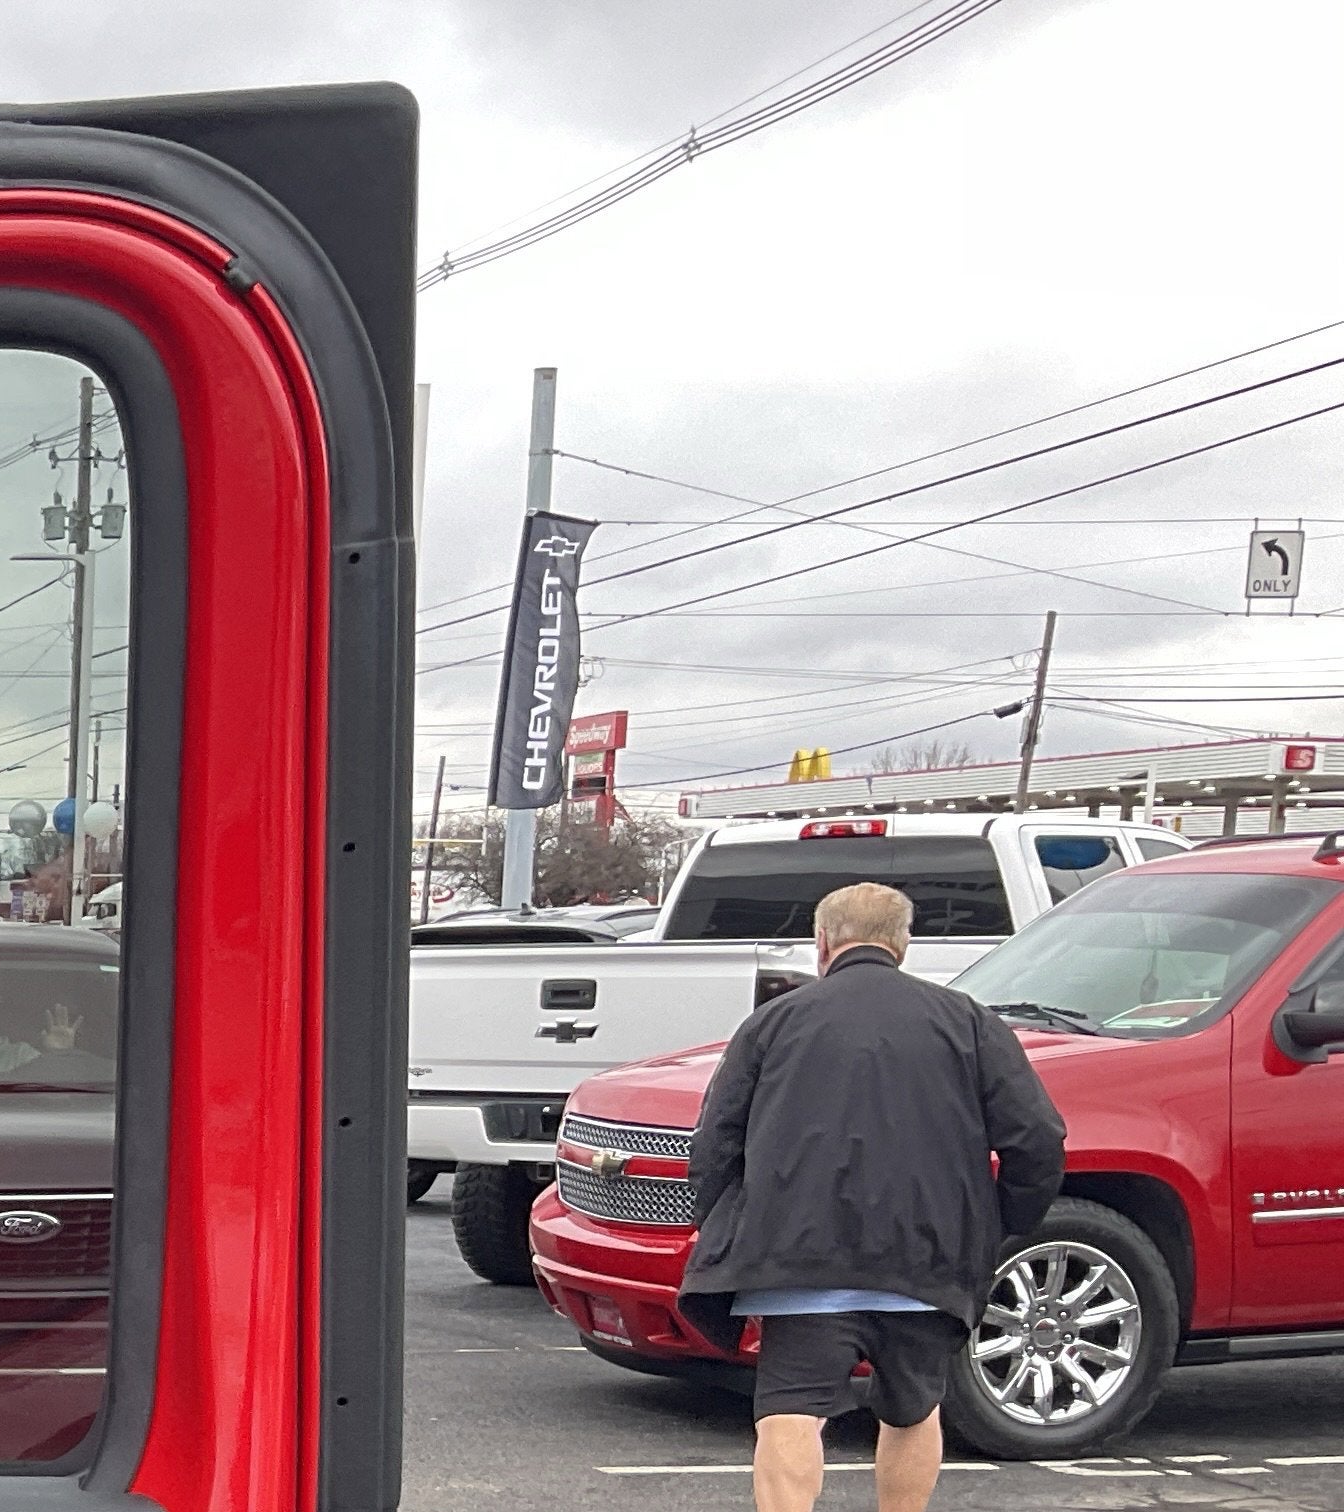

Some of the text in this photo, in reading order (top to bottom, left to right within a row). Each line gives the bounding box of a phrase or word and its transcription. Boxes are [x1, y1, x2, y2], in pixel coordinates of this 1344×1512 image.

[1252, 579, 1292, 593] ONLY
[521, 568, 563, 791] CHEVROLET
[569, 723, 612, 749] Speedway
[0, 1217, 43, 1235] Ford
